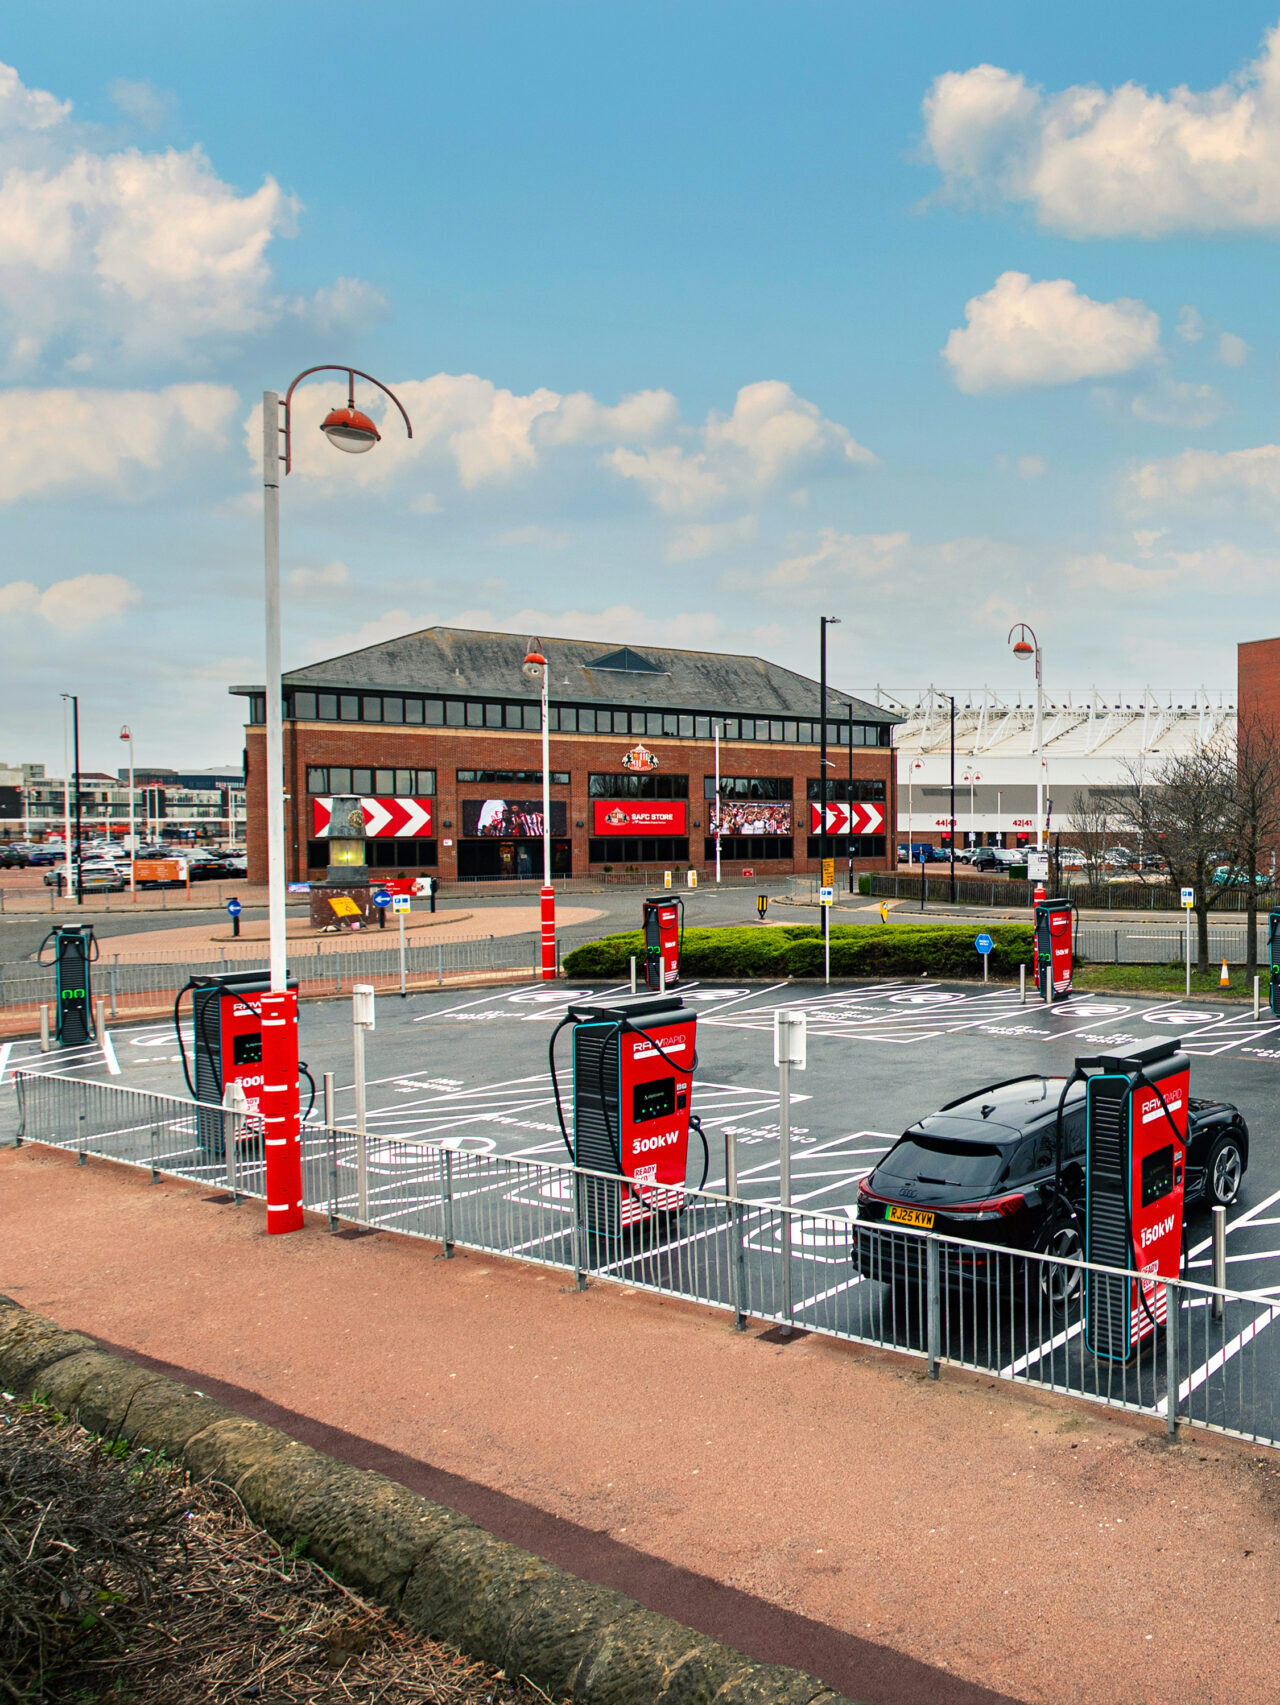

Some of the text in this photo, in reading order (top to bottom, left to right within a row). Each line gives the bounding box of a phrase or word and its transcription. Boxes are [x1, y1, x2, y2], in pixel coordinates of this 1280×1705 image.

[631, 813, 673, 821] SAFC STORE
[632, 1130, 679, 1155] 300kW
[635, 1164, 656, 1177] READY
[890, 1207, 914, 1222] RJ25
[1141, 1214, 1175, 1249] 150kW
